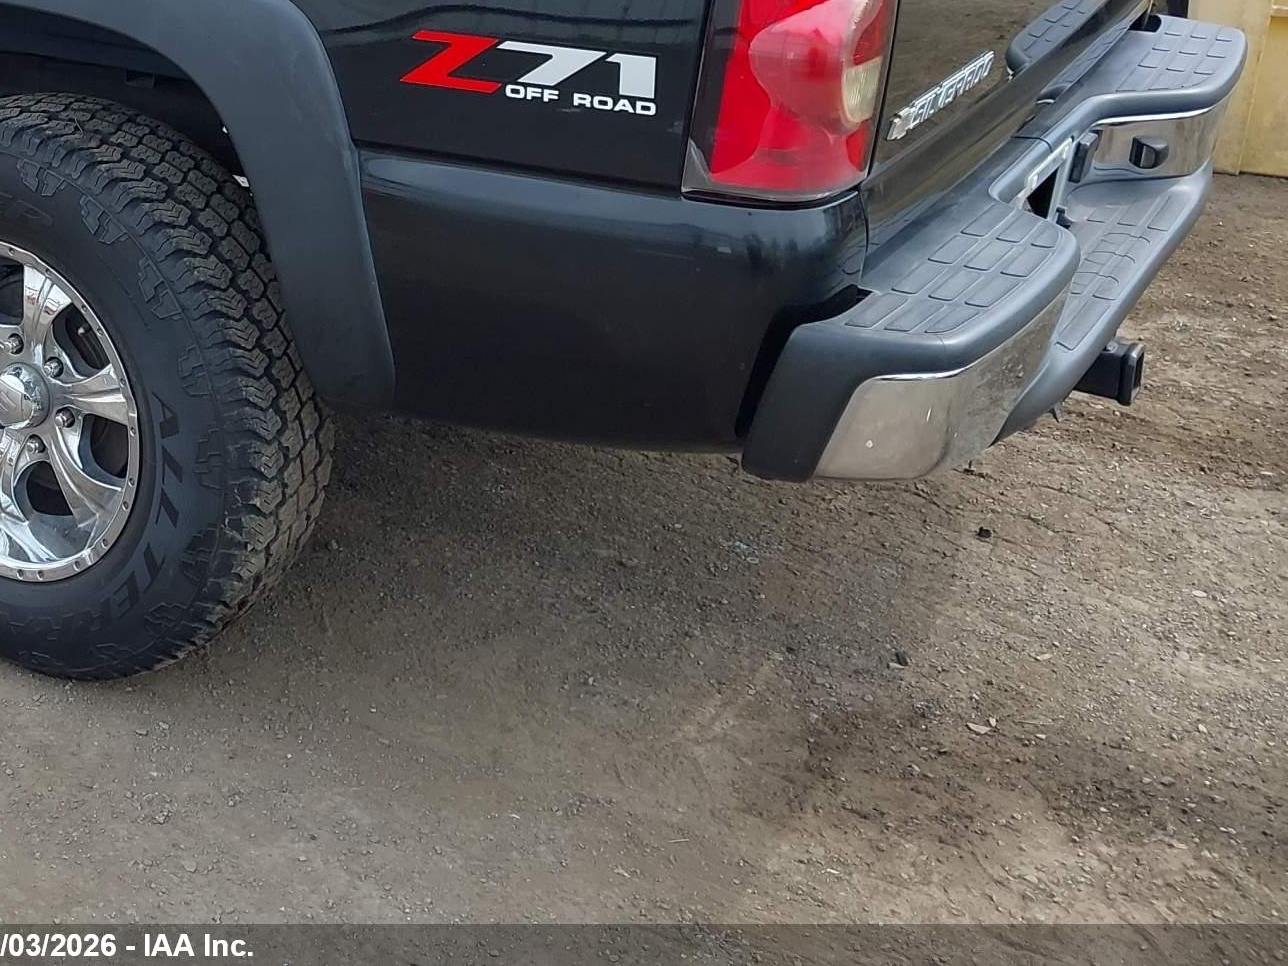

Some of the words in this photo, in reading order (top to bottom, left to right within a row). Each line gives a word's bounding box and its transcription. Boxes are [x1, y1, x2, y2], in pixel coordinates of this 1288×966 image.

[400, 30, 656, 99] Z71
[505, 84, 559, 103] OFF
[573, 93, 657, 116] ROAD
